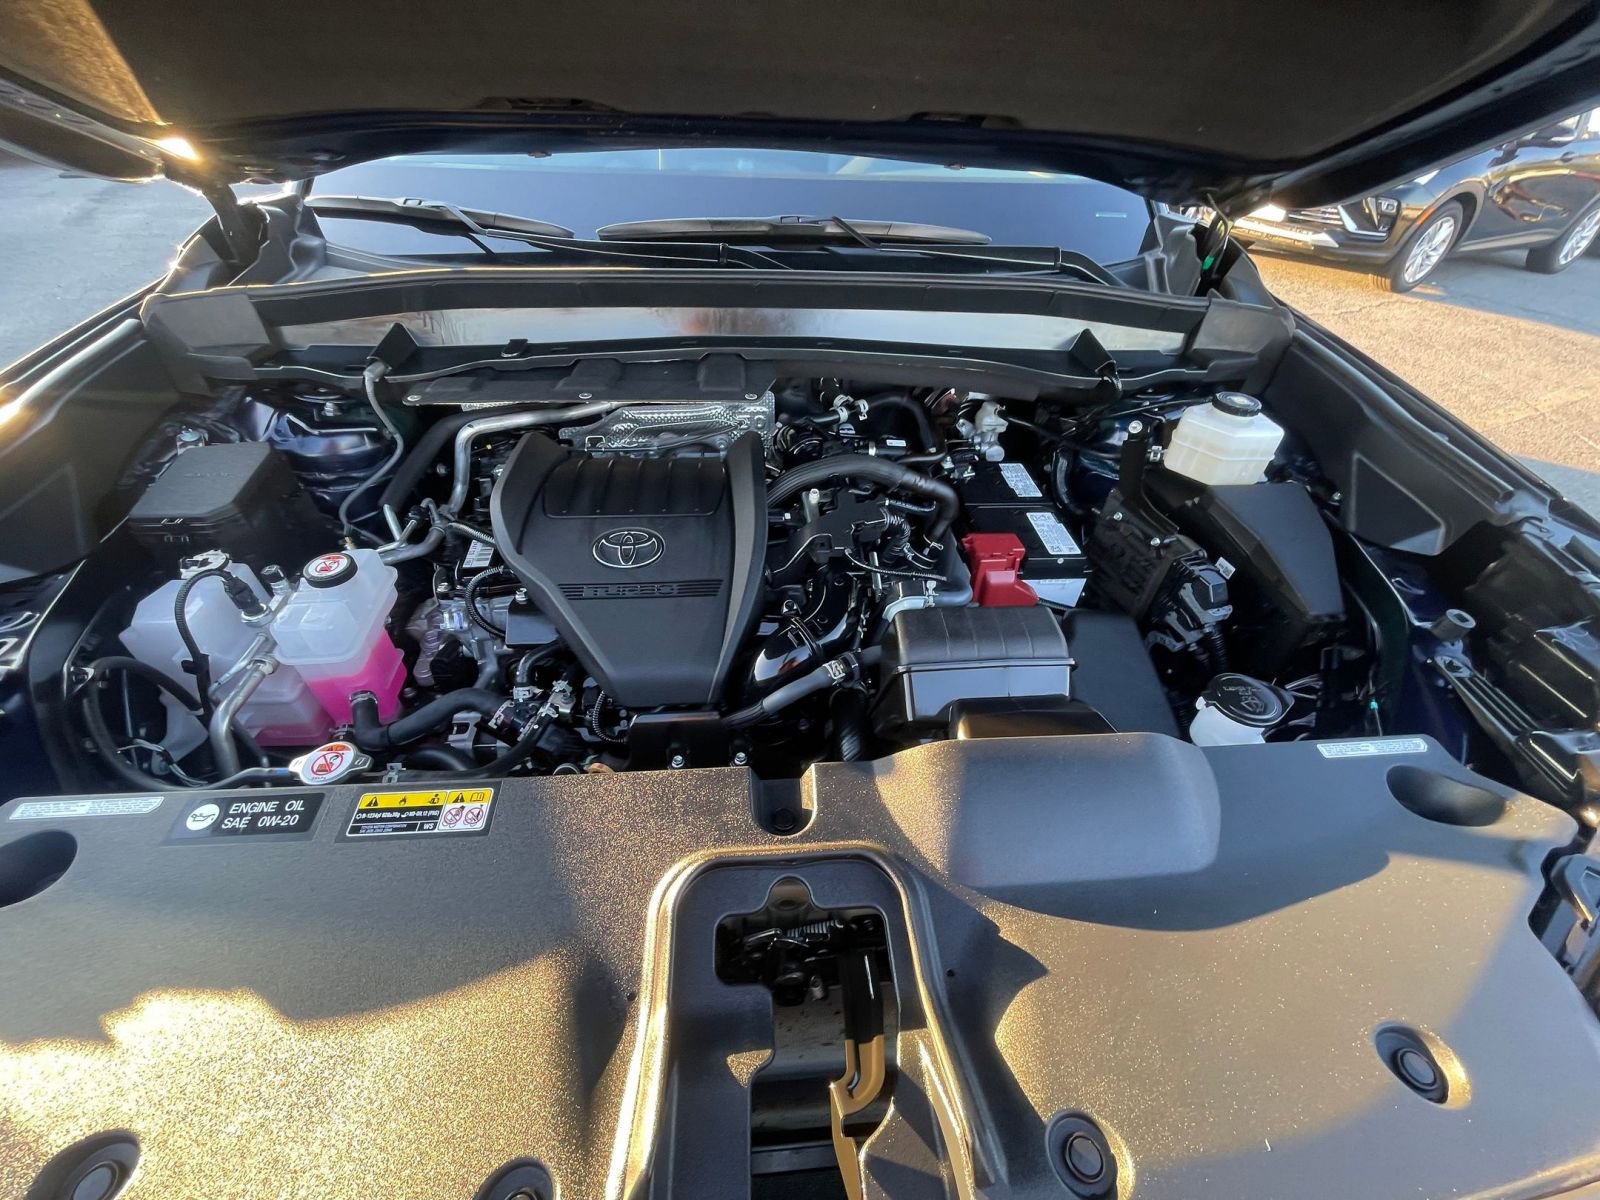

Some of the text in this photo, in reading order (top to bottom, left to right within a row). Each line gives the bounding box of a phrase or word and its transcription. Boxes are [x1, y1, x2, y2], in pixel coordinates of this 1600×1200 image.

[229, 800, 305, 814] ENGINE OIL
[222, 814, 299, 829] SAE 0W-20
